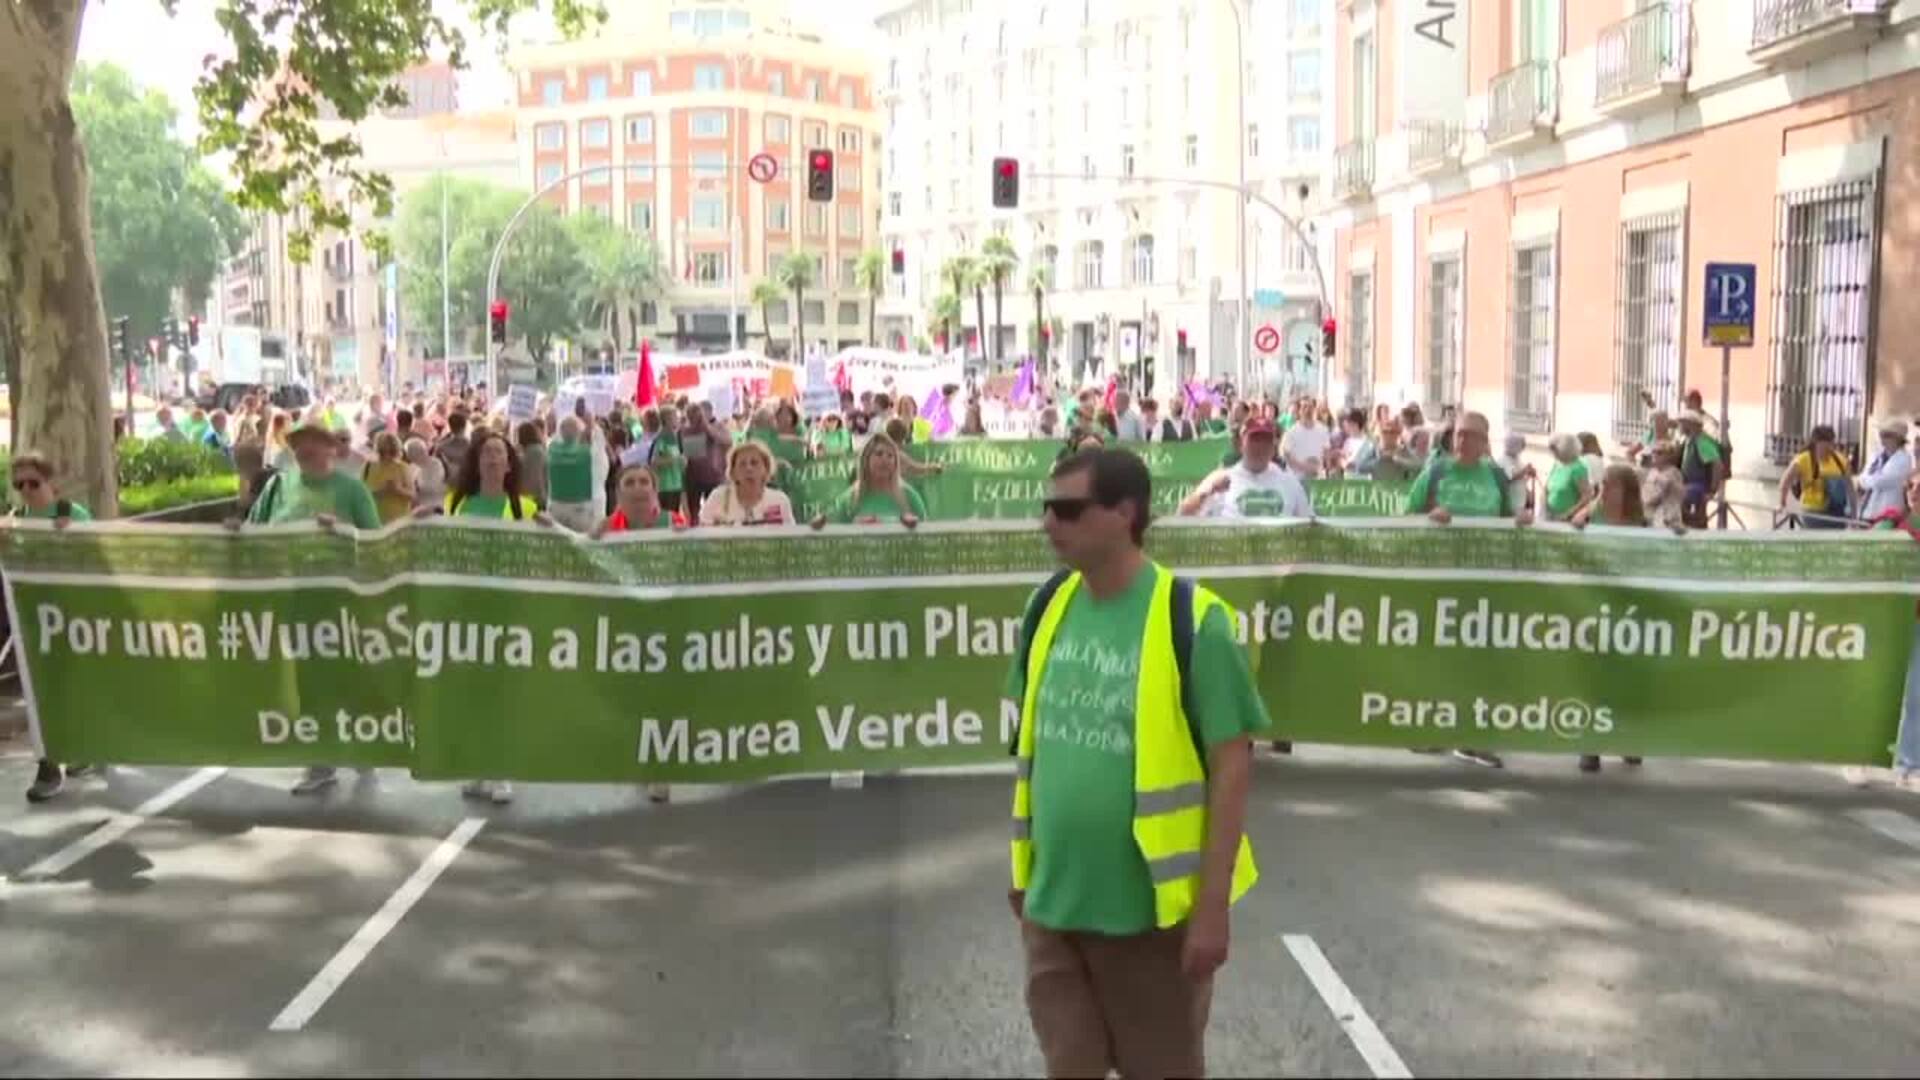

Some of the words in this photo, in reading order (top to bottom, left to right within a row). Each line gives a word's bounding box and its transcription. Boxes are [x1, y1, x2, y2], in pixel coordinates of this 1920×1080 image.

[1720, 273, 1747, 316] P
[39, 604, 110, 653] Por
[124, 622, 206, 660] una
[549, 628, 578, 669] a
[596, 616, 667, 673] las
[683, 615, 794, 671] aulas
[807, 623, 832, 676] y
[847, 620, 908, 660] un
[1306, 592, 1364, 645] de
[1378, 595, 1418, 646] la
[1434, 598, 1673, 656] Educación
[1688, 610, 1867, 661] Pública
[258, 710, 319, 744] De
[638, 717, 801, 764] Marea
[816, 698, 983, 752] Verde
[1361, 692, 1458, 730] Para
[1473, 696, 1615, 740] tod@s
